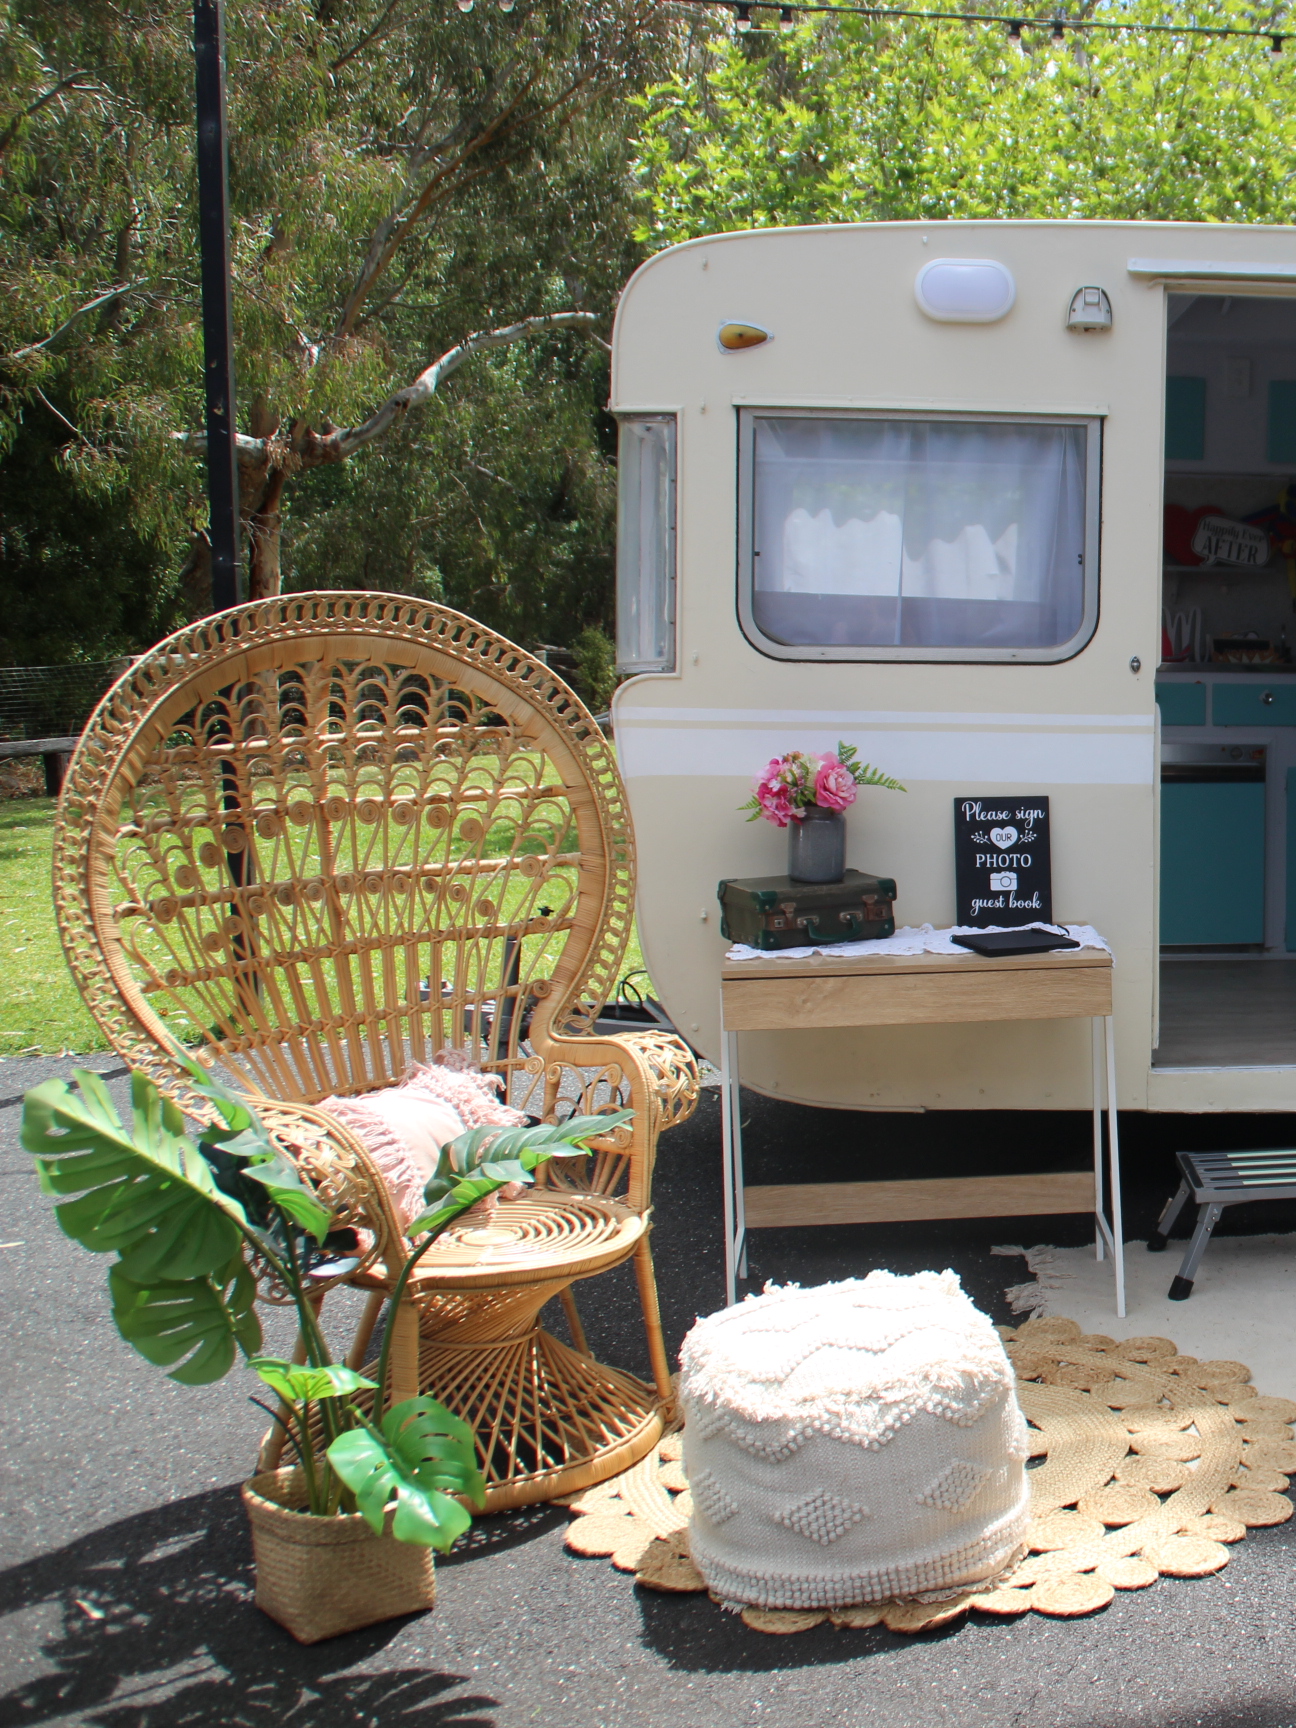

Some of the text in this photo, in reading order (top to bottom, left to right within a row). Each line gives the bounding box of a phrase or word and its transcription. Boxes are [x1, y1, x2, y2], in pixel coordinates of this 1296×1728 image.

[1203, 521, 1265, 542] Happily Ever
[1202, 536, 1258, 563] AFTER
[962, 801, 1045, 828] Please sign
[996, 833, 1012, 842] OUR
[976, 854, 1031, 867] PHOTO
[970, 891, 1042, 916] guest book
